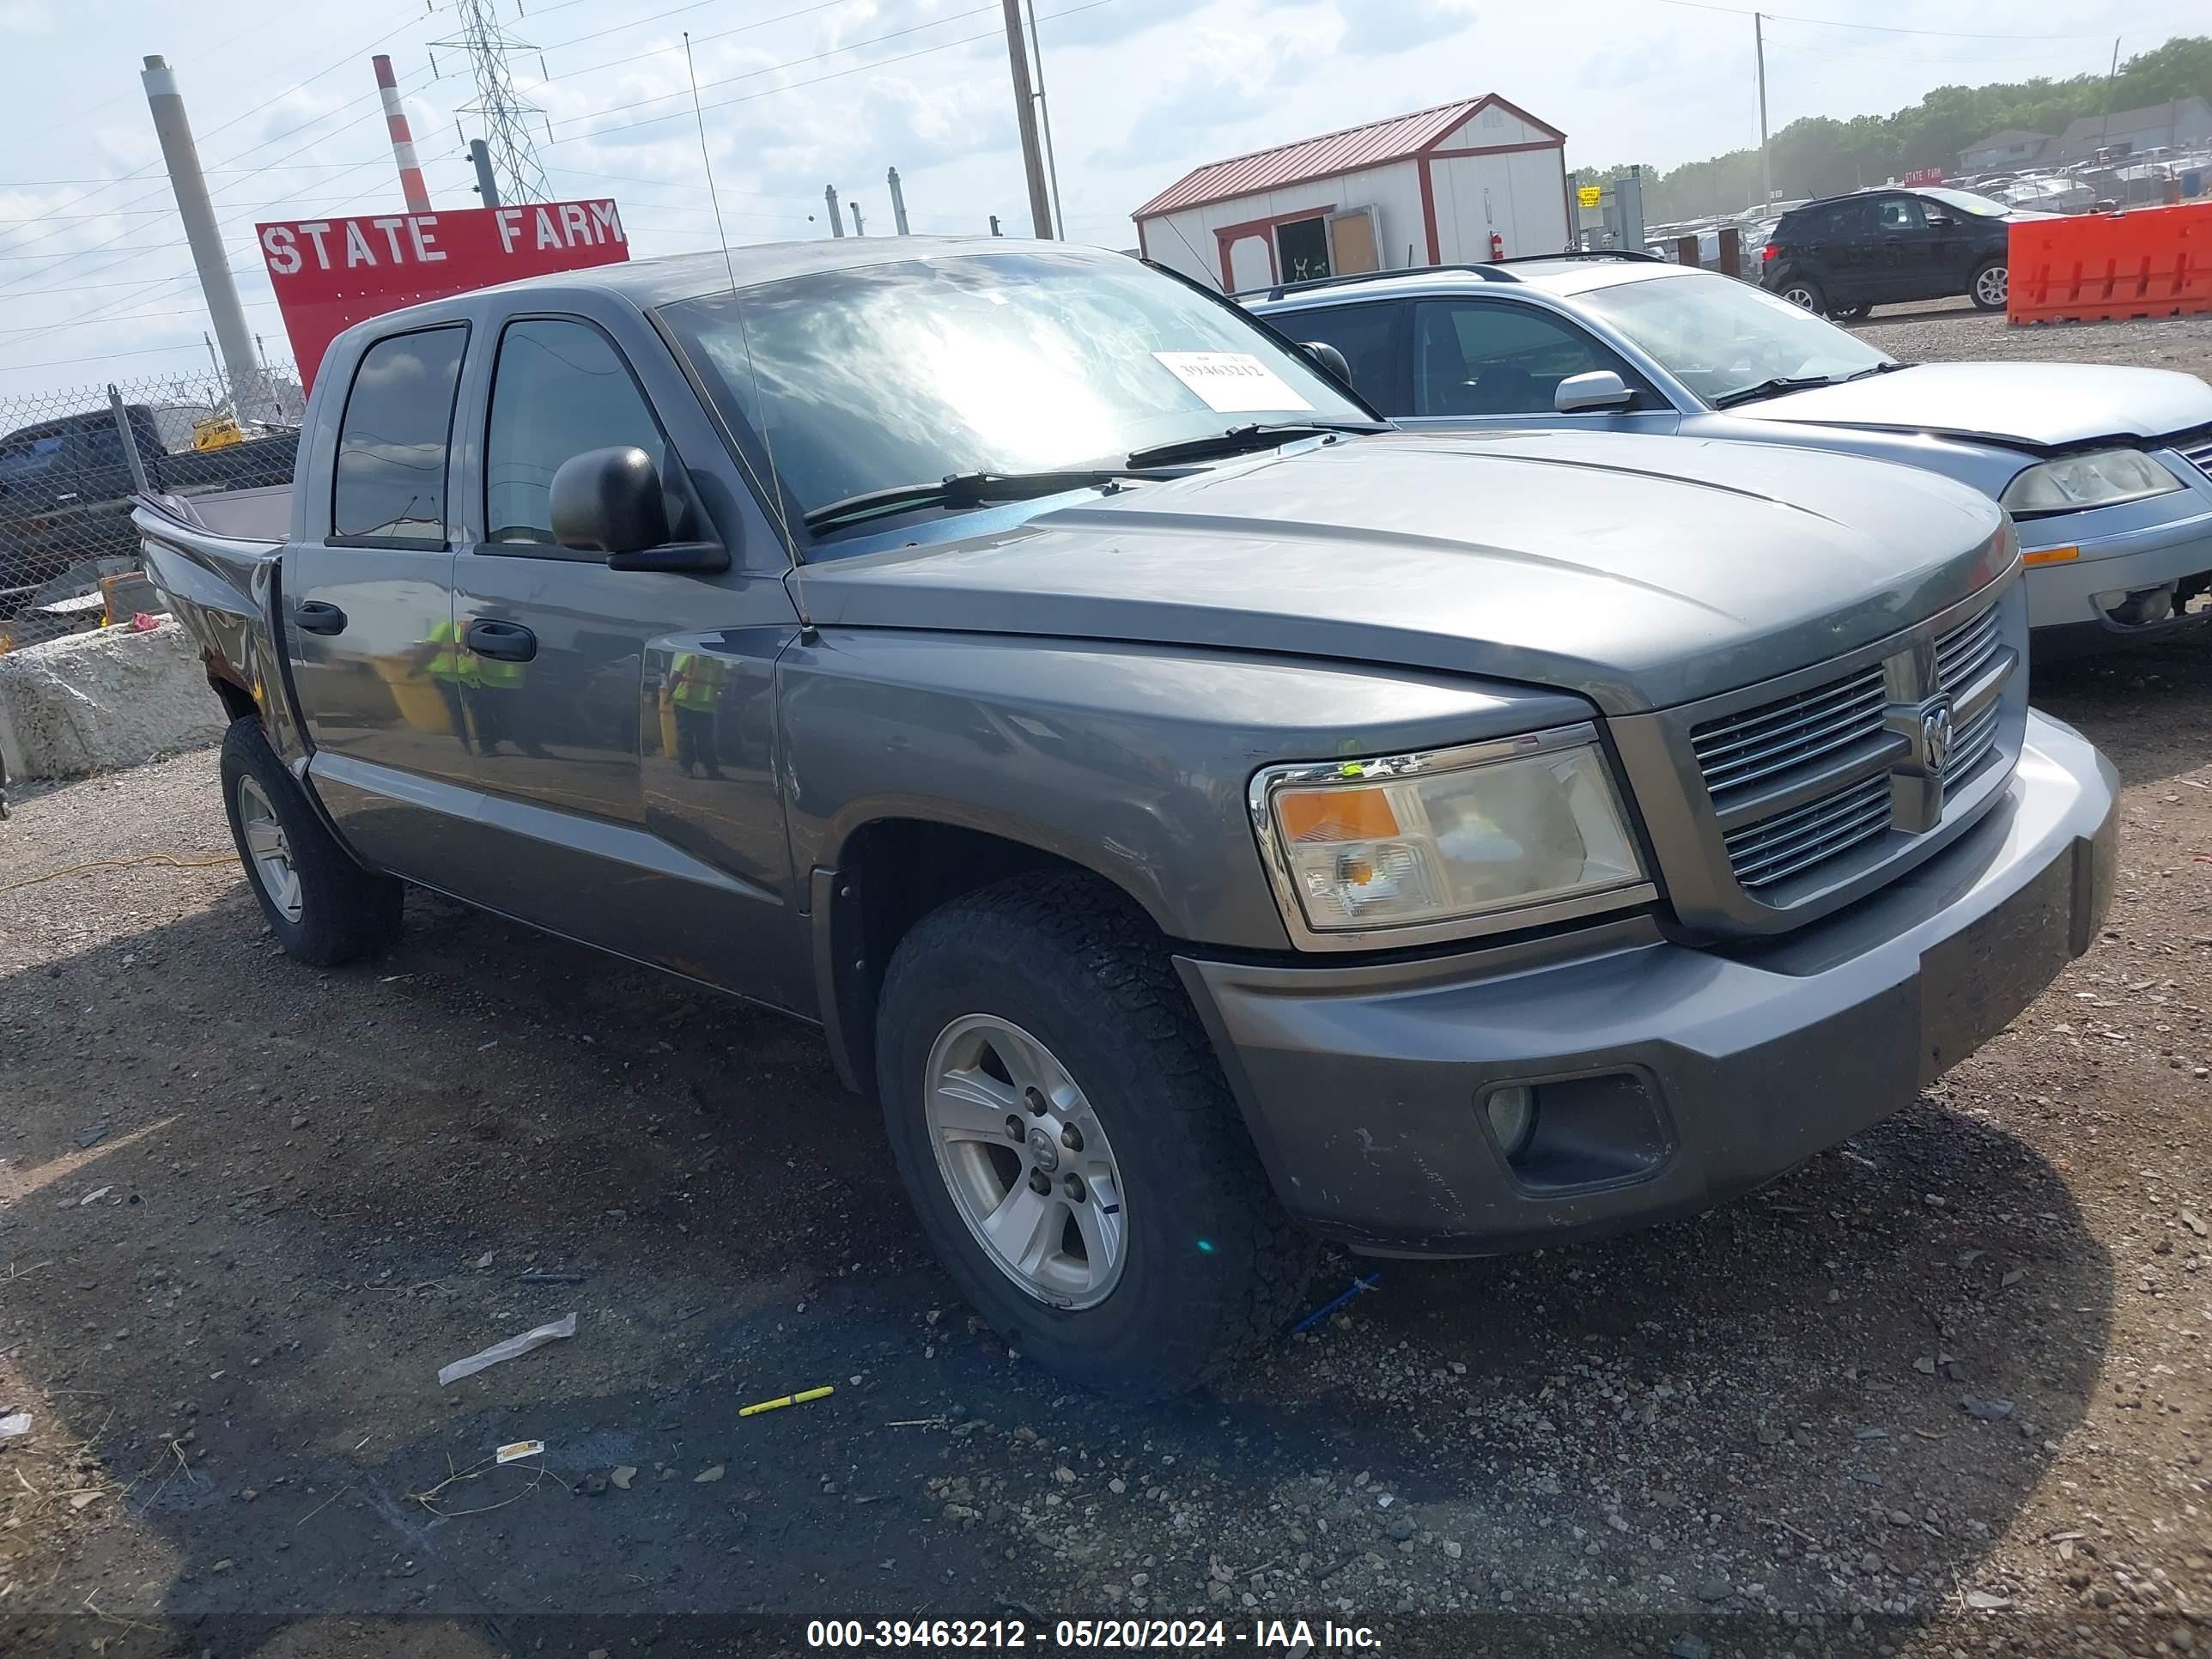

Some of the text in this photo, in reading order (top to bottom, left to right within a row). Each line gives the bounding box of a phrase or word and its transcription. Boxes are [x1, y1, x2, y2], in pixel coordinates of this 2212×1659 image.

[1905, 170, 1923, 183] STATE
[262, 202, 623, 275] STATE FARM
[1179, 365, 1265, 377] 39463212
